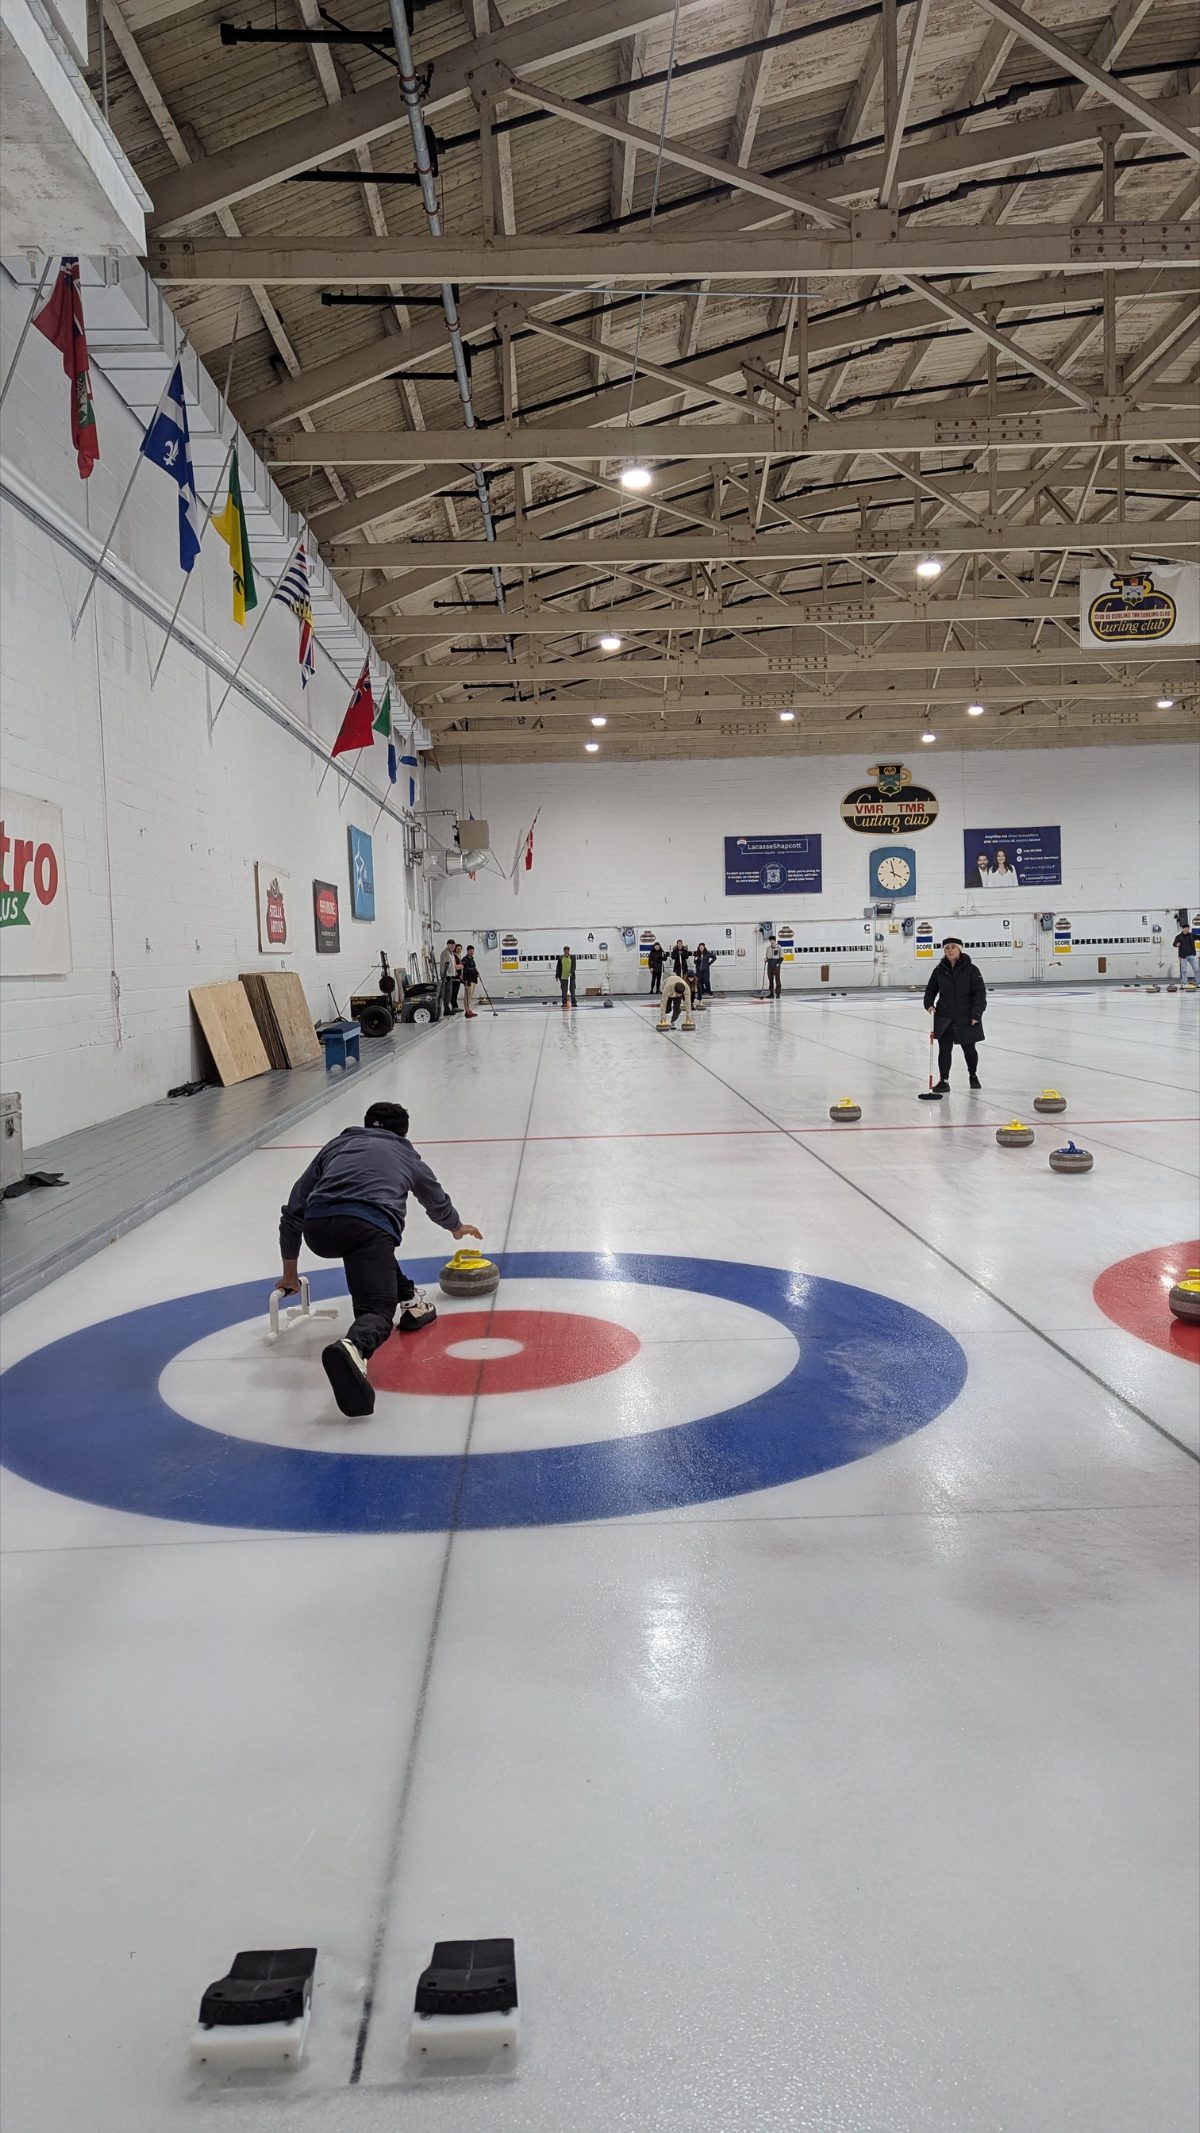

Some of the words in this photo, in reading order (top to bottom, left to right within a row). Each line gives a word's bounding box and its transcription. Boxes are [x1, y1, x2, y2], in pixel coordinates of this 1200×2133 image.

[1100, 603, 1139, 633] Curling
[1141, 604, 1167, 630] club
[853, 794, 900, 833] Curling
[904, 798, 930, 825] club
[855, 805, 884, 814] VMR
[897, 803, 925, 812] TMR
[0, 897, 18, 920] US
